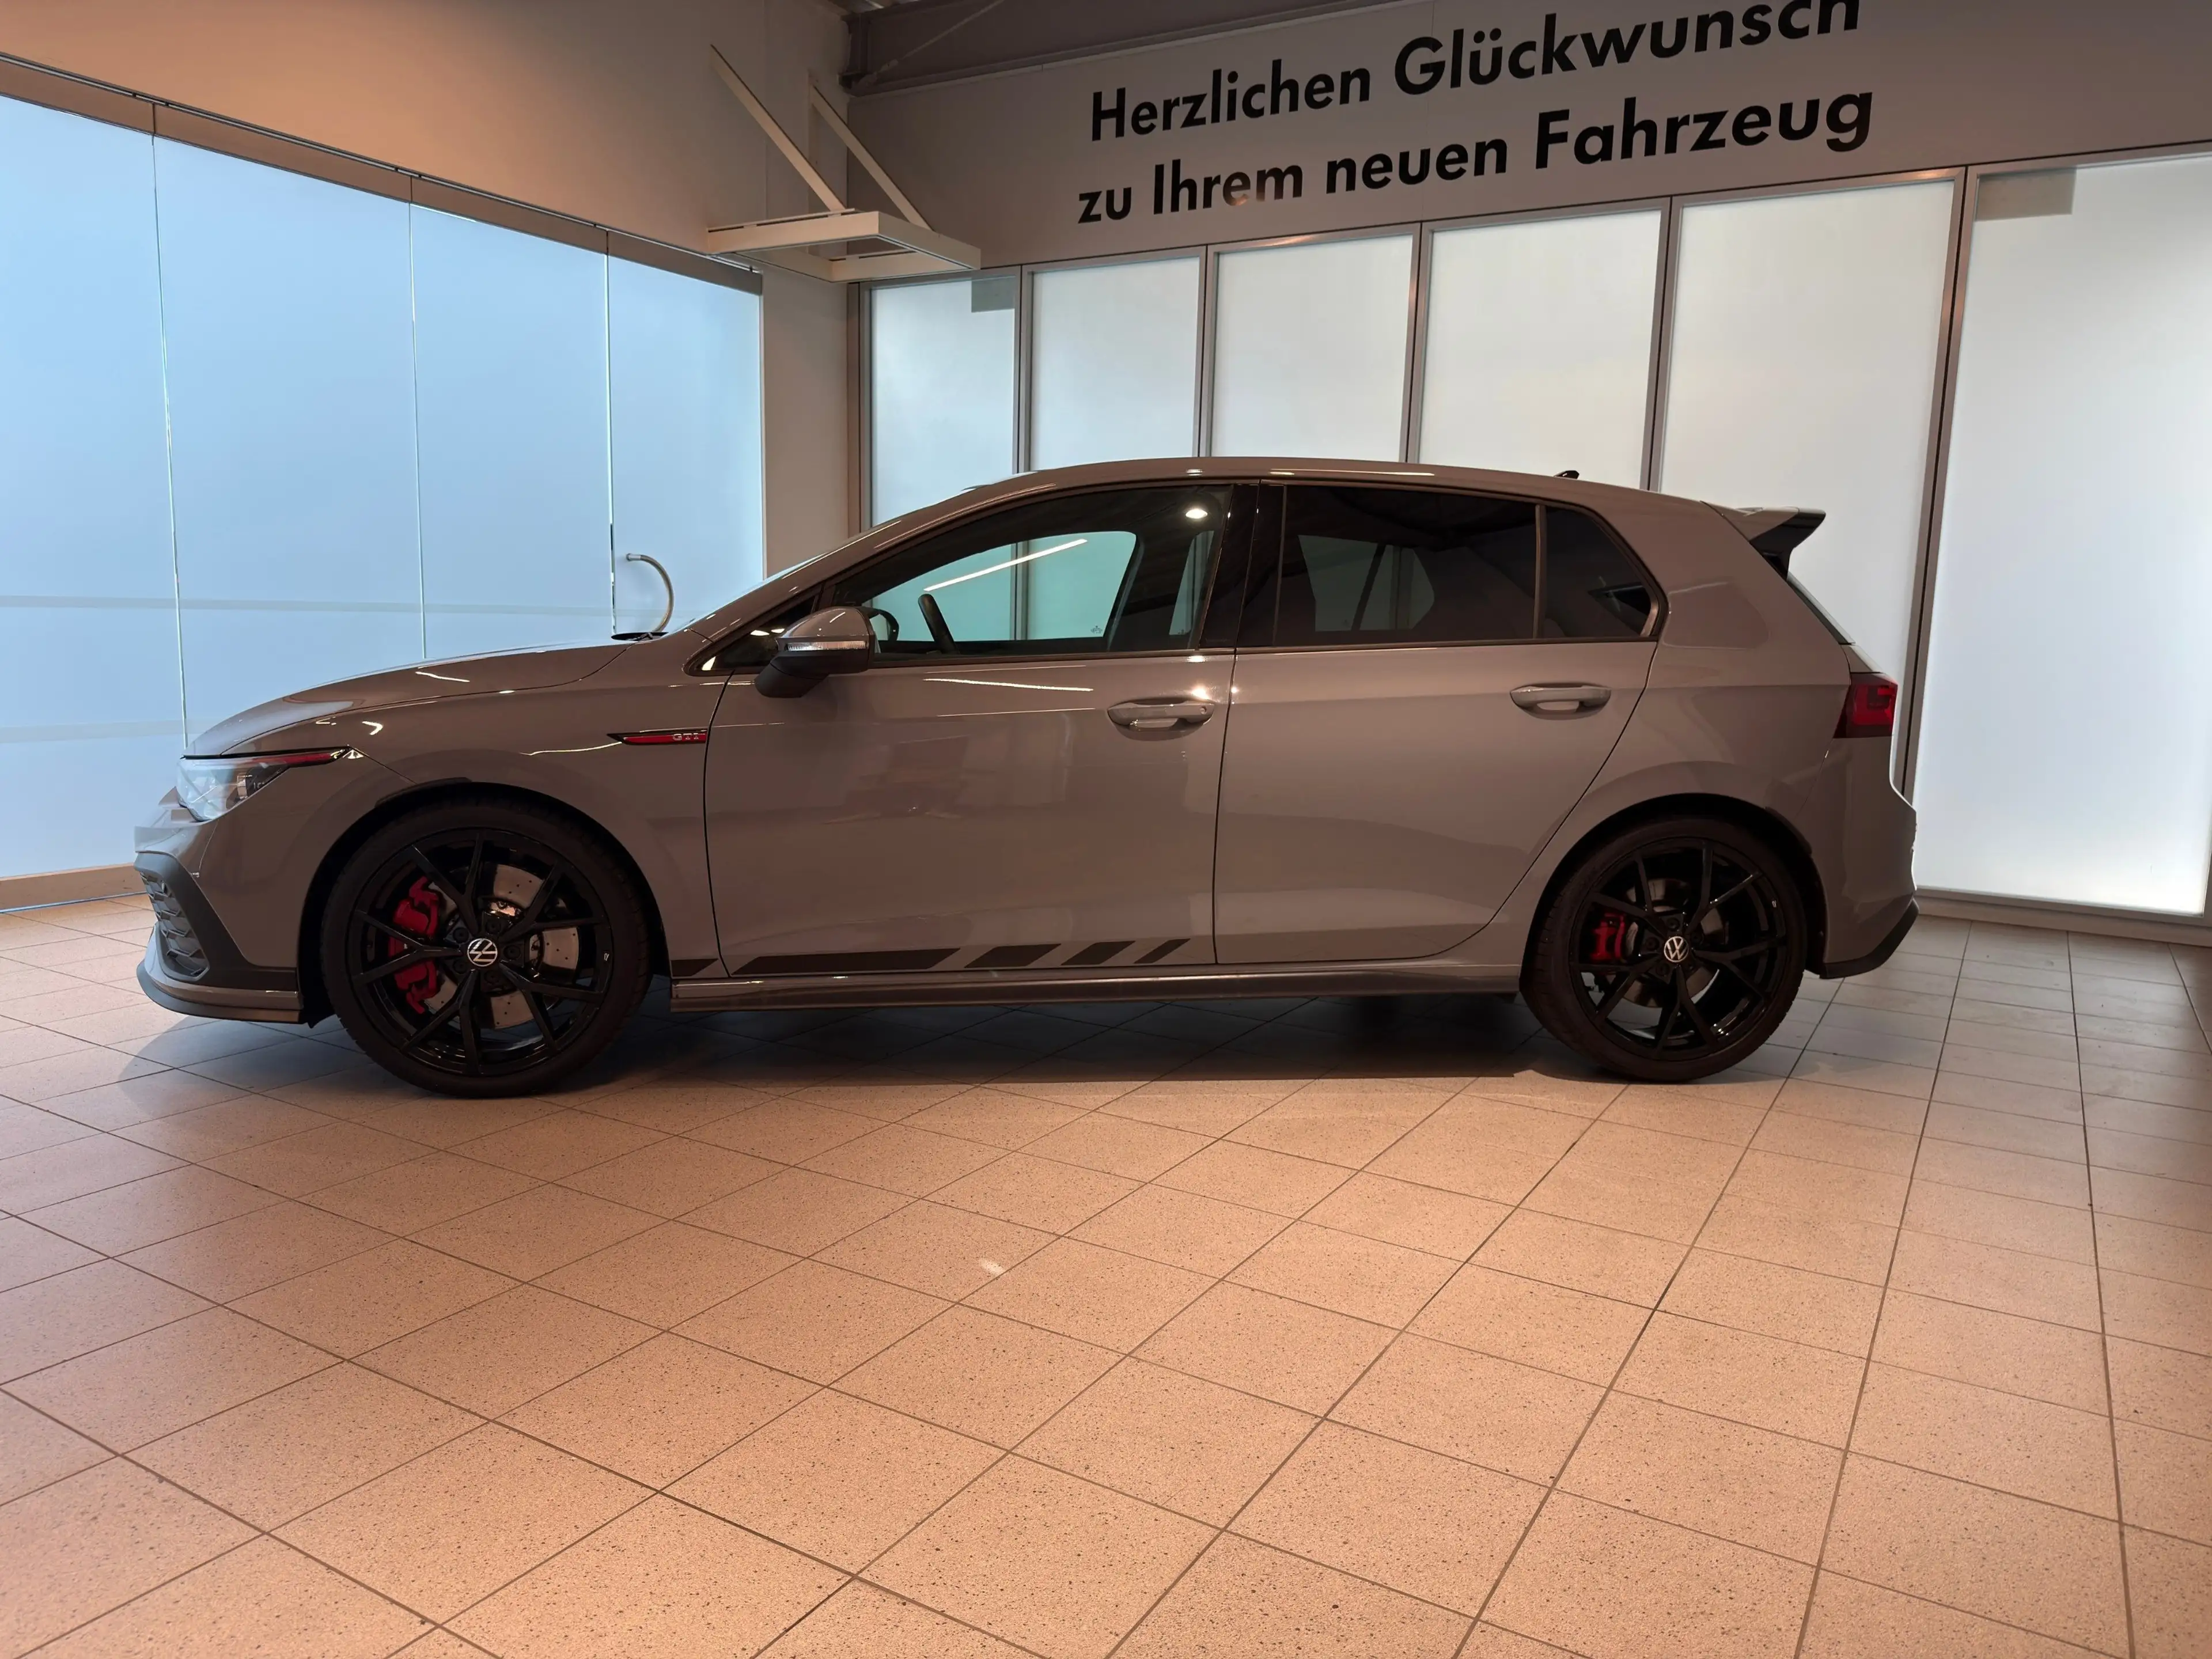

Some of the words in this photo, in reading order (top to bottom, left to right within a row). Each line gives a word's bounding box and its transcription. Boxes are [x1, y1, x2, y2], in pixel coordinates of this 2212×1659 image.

[1092, 59, 1370, 142] Herzlichen
[1078, 187, 1132, 224] zu
[1153, 158, 1303, 215] Ihrem
[1326, 139, 1508, 194] neuen
[1536, 92, 1873, 169] Fahrzeug
[672, 733, 699, 741] GTI
